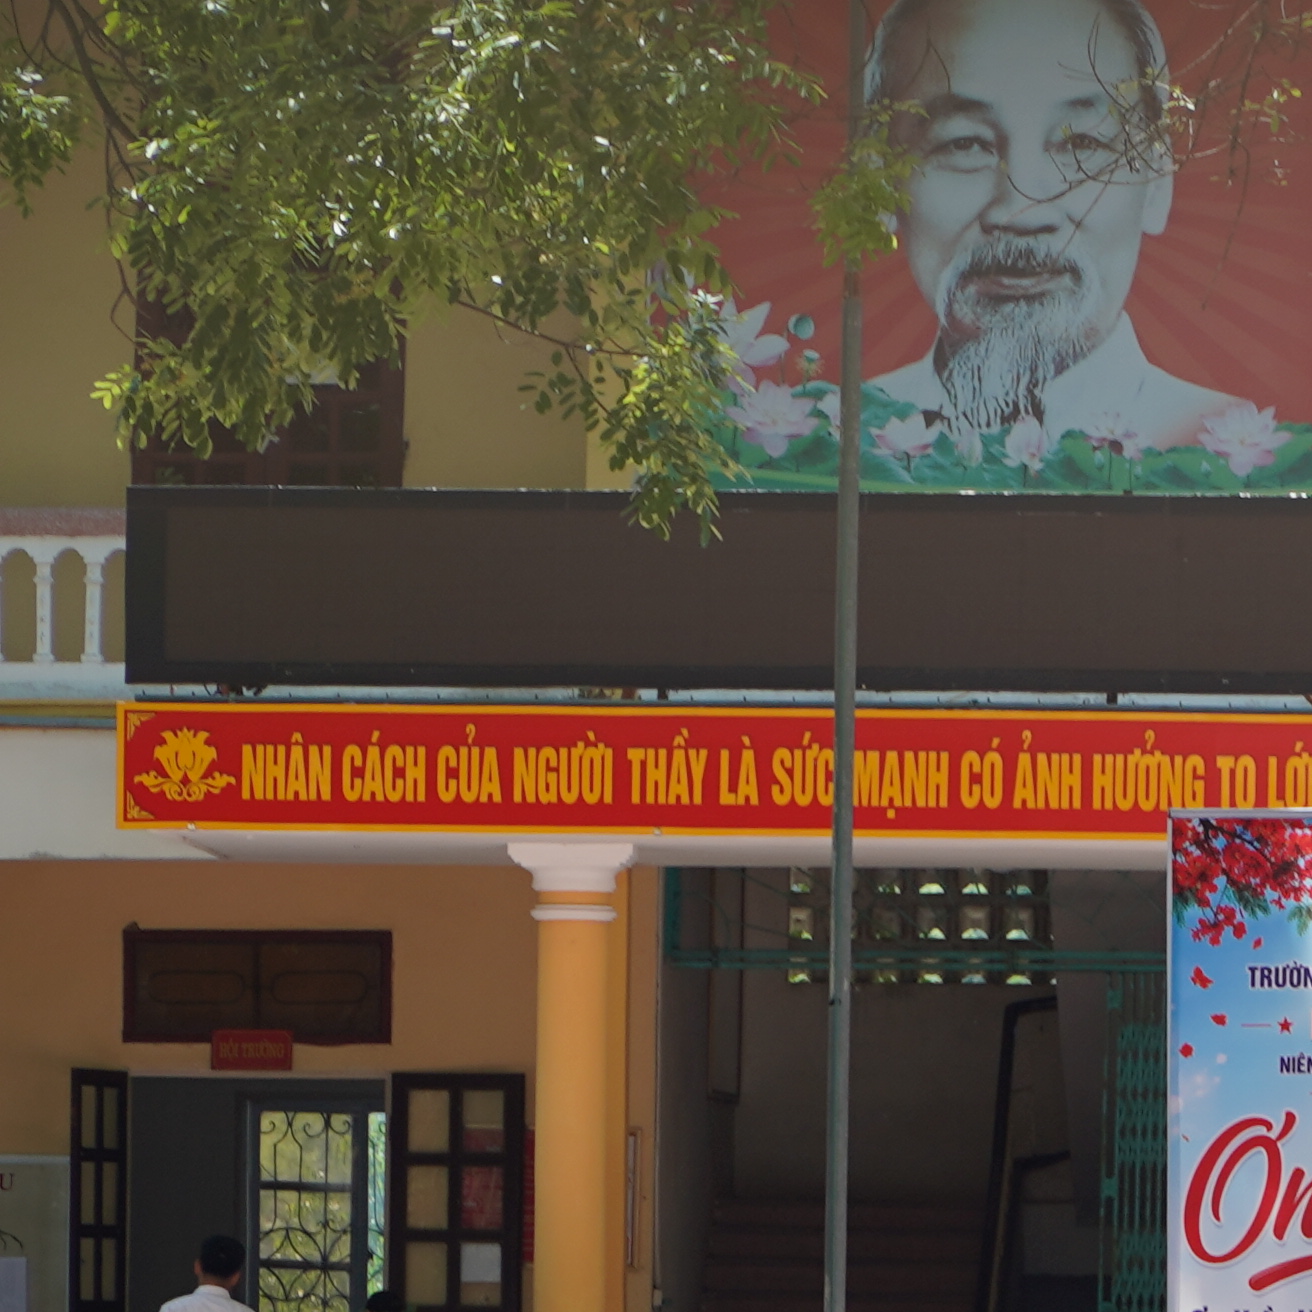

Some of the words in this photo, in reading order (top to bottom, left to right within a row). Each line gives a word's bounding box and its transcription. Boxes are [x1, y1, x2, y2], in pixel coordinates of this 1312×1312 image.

[241, 732, 331, 802] NHÂN
[341, 730, 426, 803] CÁCH
[437, 724, 501, 804] CỦA
[513, 731, 613, 805] NGƯỜI
[628, 727, 704, 807] THẦY
[719, 735, 760, 806] LÀ
[771, 731, 834, 807] SỨC
[853, 750, 949, 819] MẠNH
[960, 736, 1004, 810] CÓ
[1013, 730, 1081, 811] ẢNH
[1093, 729, 1205, 811] HƯỞNG
[1216, 755, 1256, 809] TO
